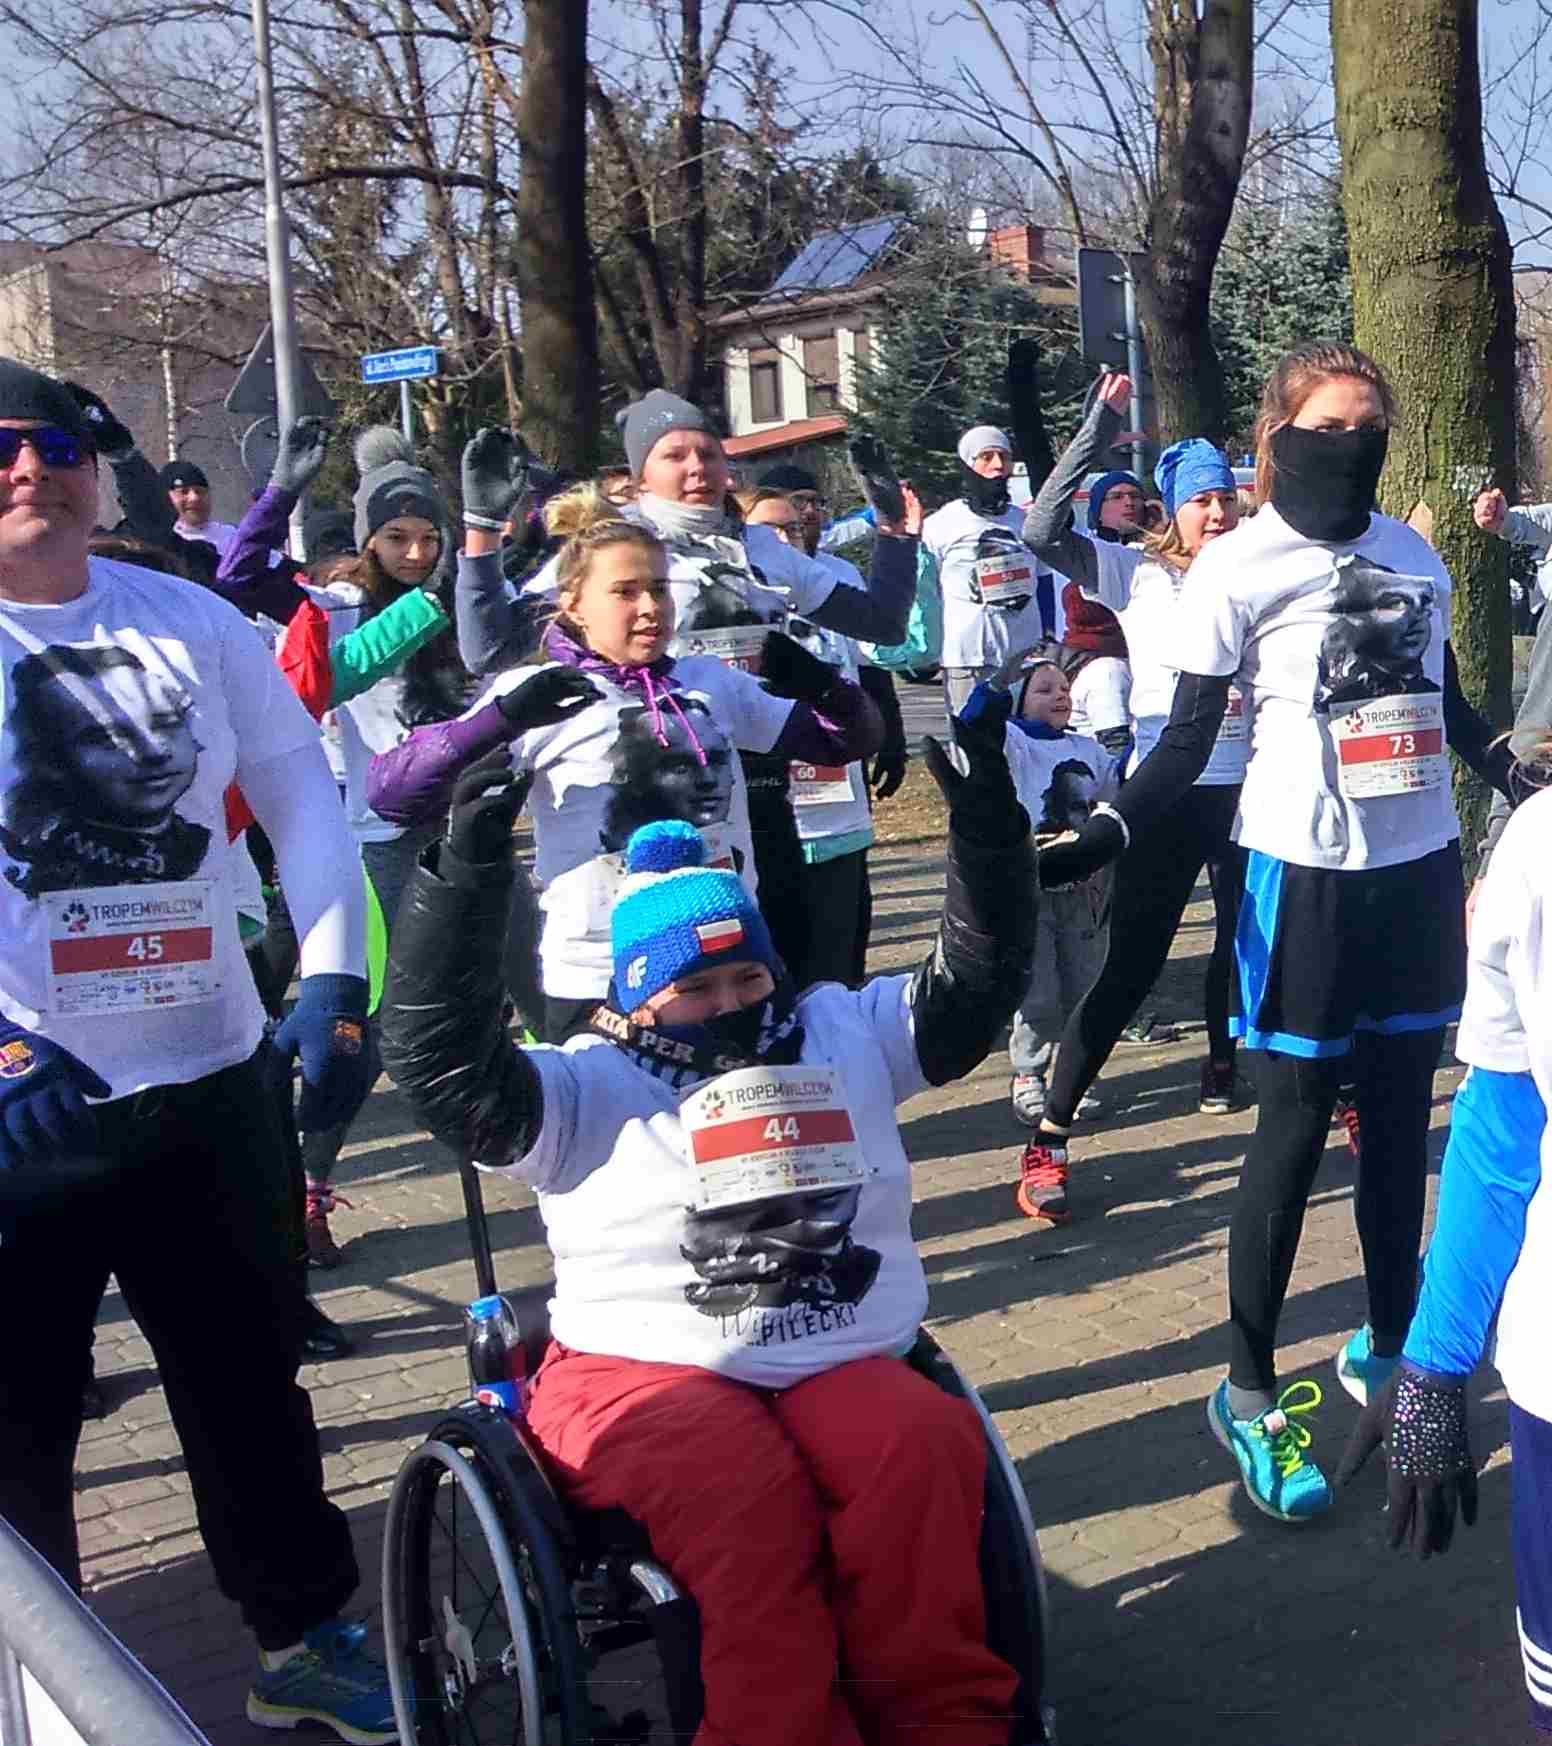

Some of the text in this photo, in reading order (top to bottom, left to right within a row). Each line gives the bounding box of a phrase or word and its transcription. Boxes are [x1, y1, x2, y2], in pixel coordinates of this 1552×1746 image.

[1390, 734, 1416, 755] 73
[92, 899, 203, 921] TROPEMWILCZYM
[127, 934, 164, 960] 45
[727, 1081, 833, 1104] TROPEMWILCZYM
[764, 1116, 800, 1142] 44
[762, 1303, 857, 1346] PILECKI
